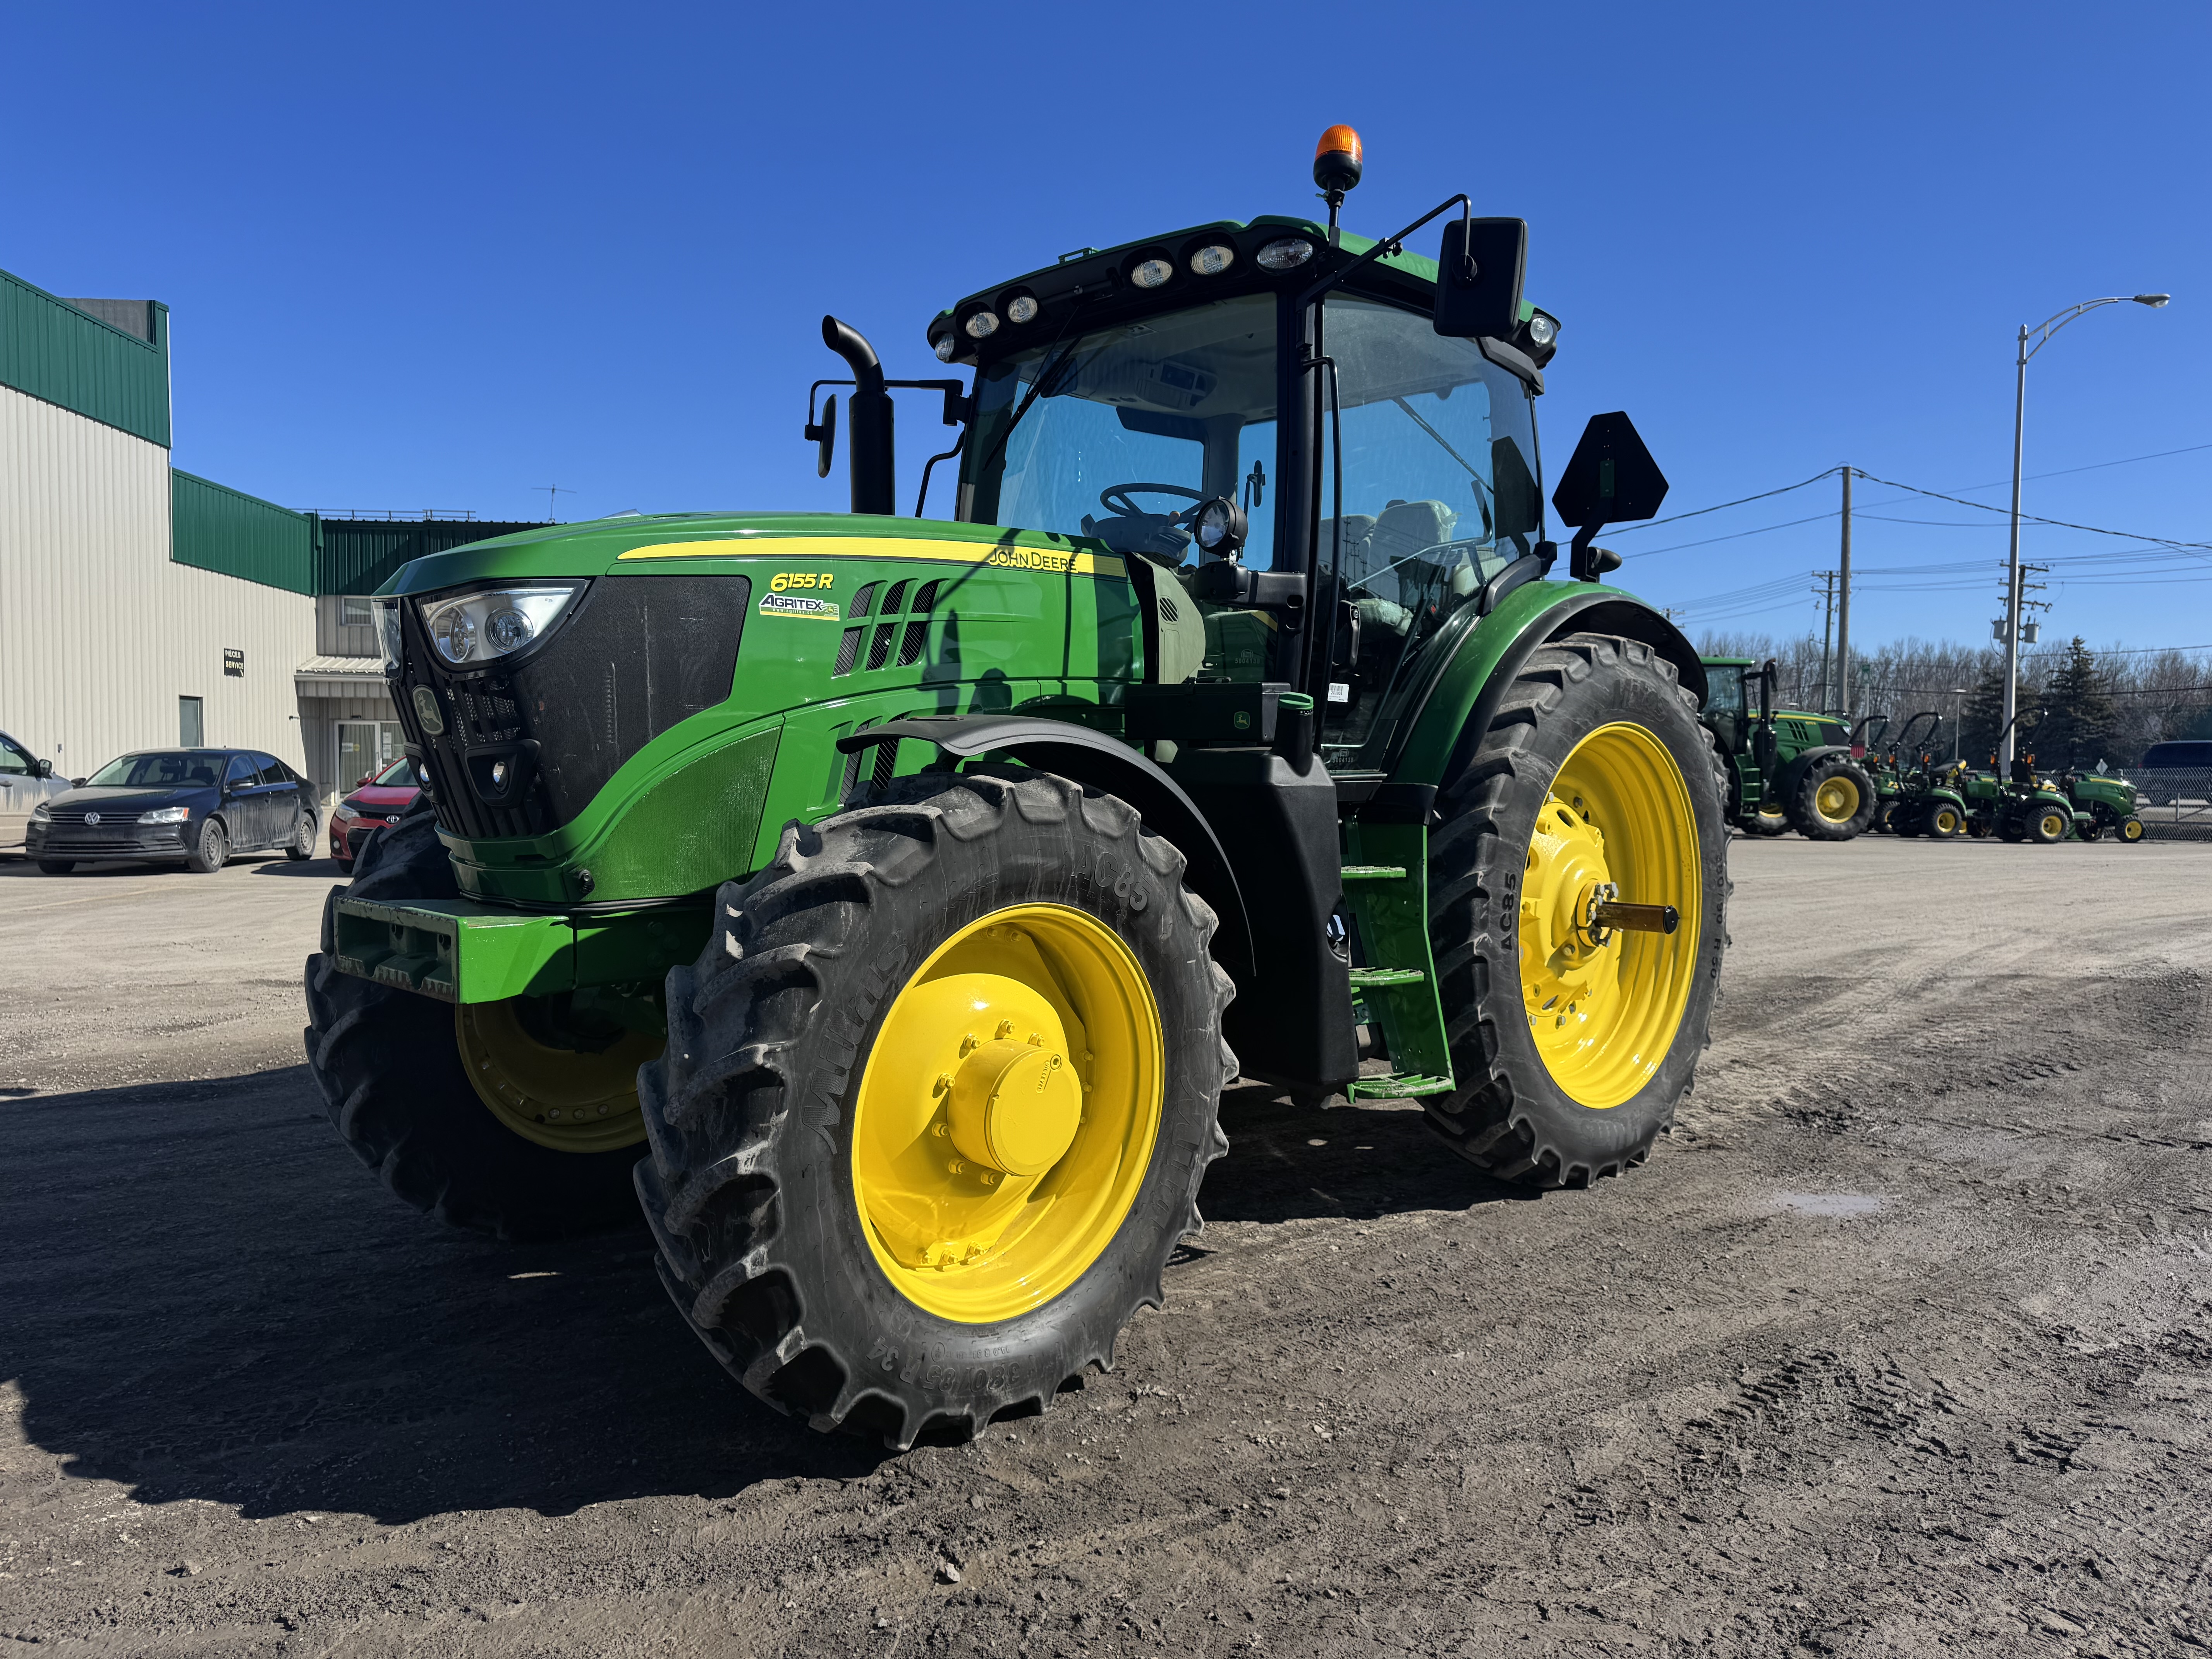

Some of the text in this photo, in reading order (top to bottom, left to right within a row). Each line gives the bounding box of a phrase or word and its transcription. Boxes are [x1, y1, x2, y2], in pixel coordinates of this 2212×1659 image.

[990, 548, 1077, 571] JOHN DEERE
[761, 595, 823, 611] AGRITEX
[225, 660, 244, 670] SERVICE
[1501, 872, 1516, 951] AC85
